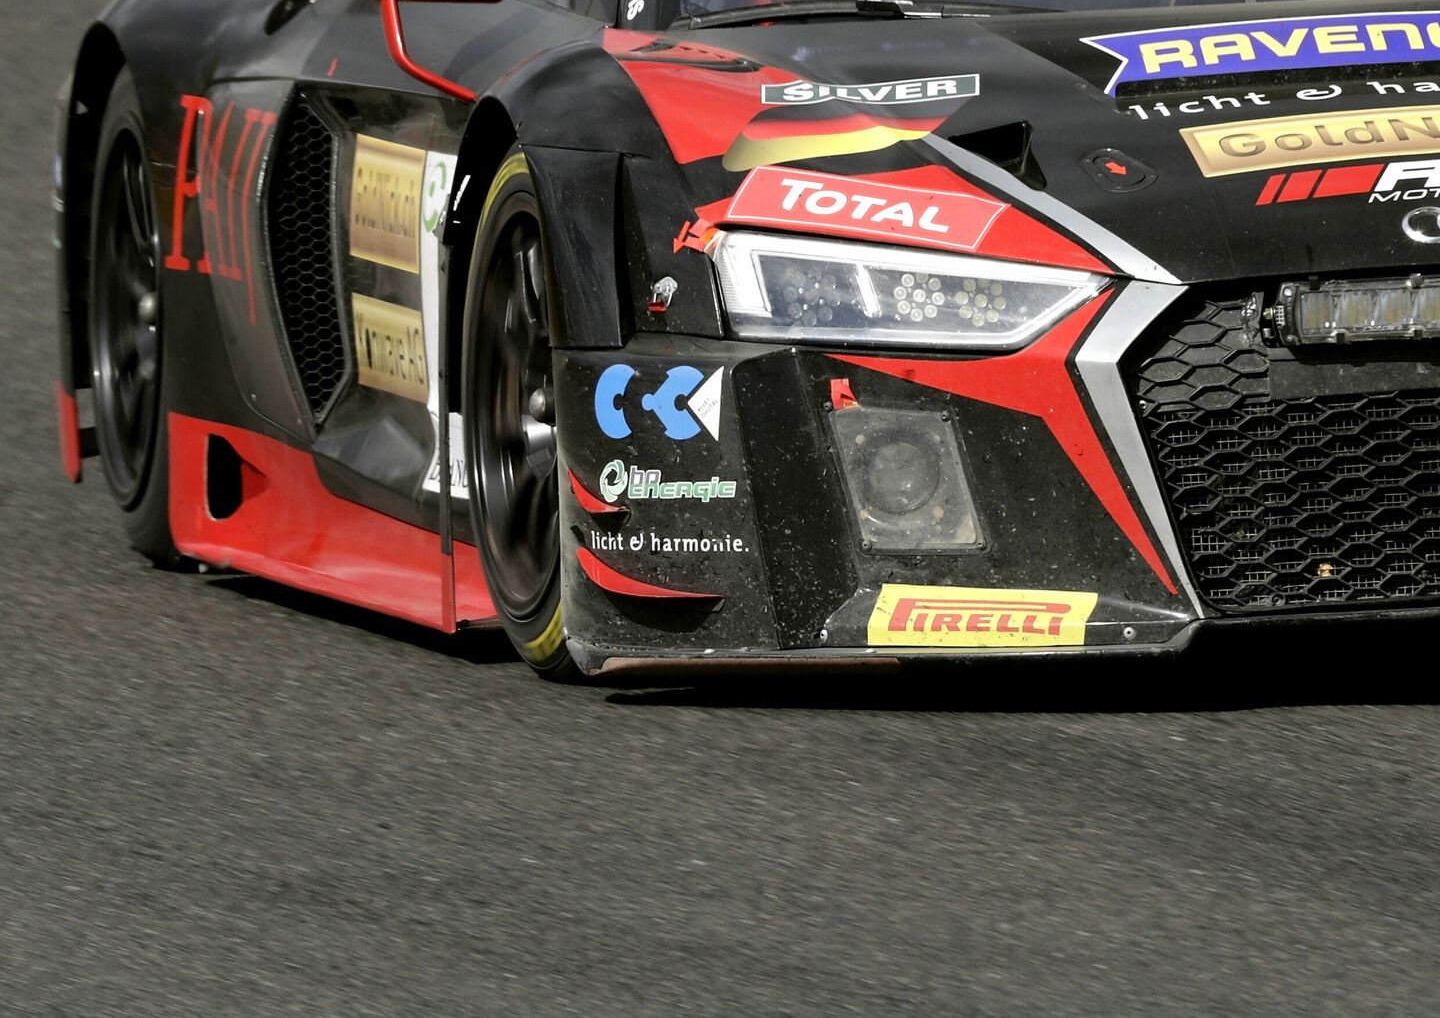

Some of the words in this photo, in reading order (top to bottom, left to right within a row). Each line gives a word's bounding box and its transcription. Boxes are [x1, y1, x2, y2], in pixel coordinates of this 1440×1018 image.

[783, 79, 958, 102] SILVER
[1128, 89, 1272, 121] licht
[780, 178, 950, 234] TOTAL
[590, 531, 624, 551] licht
[888, 598, 1072, 636] PIRELLI
